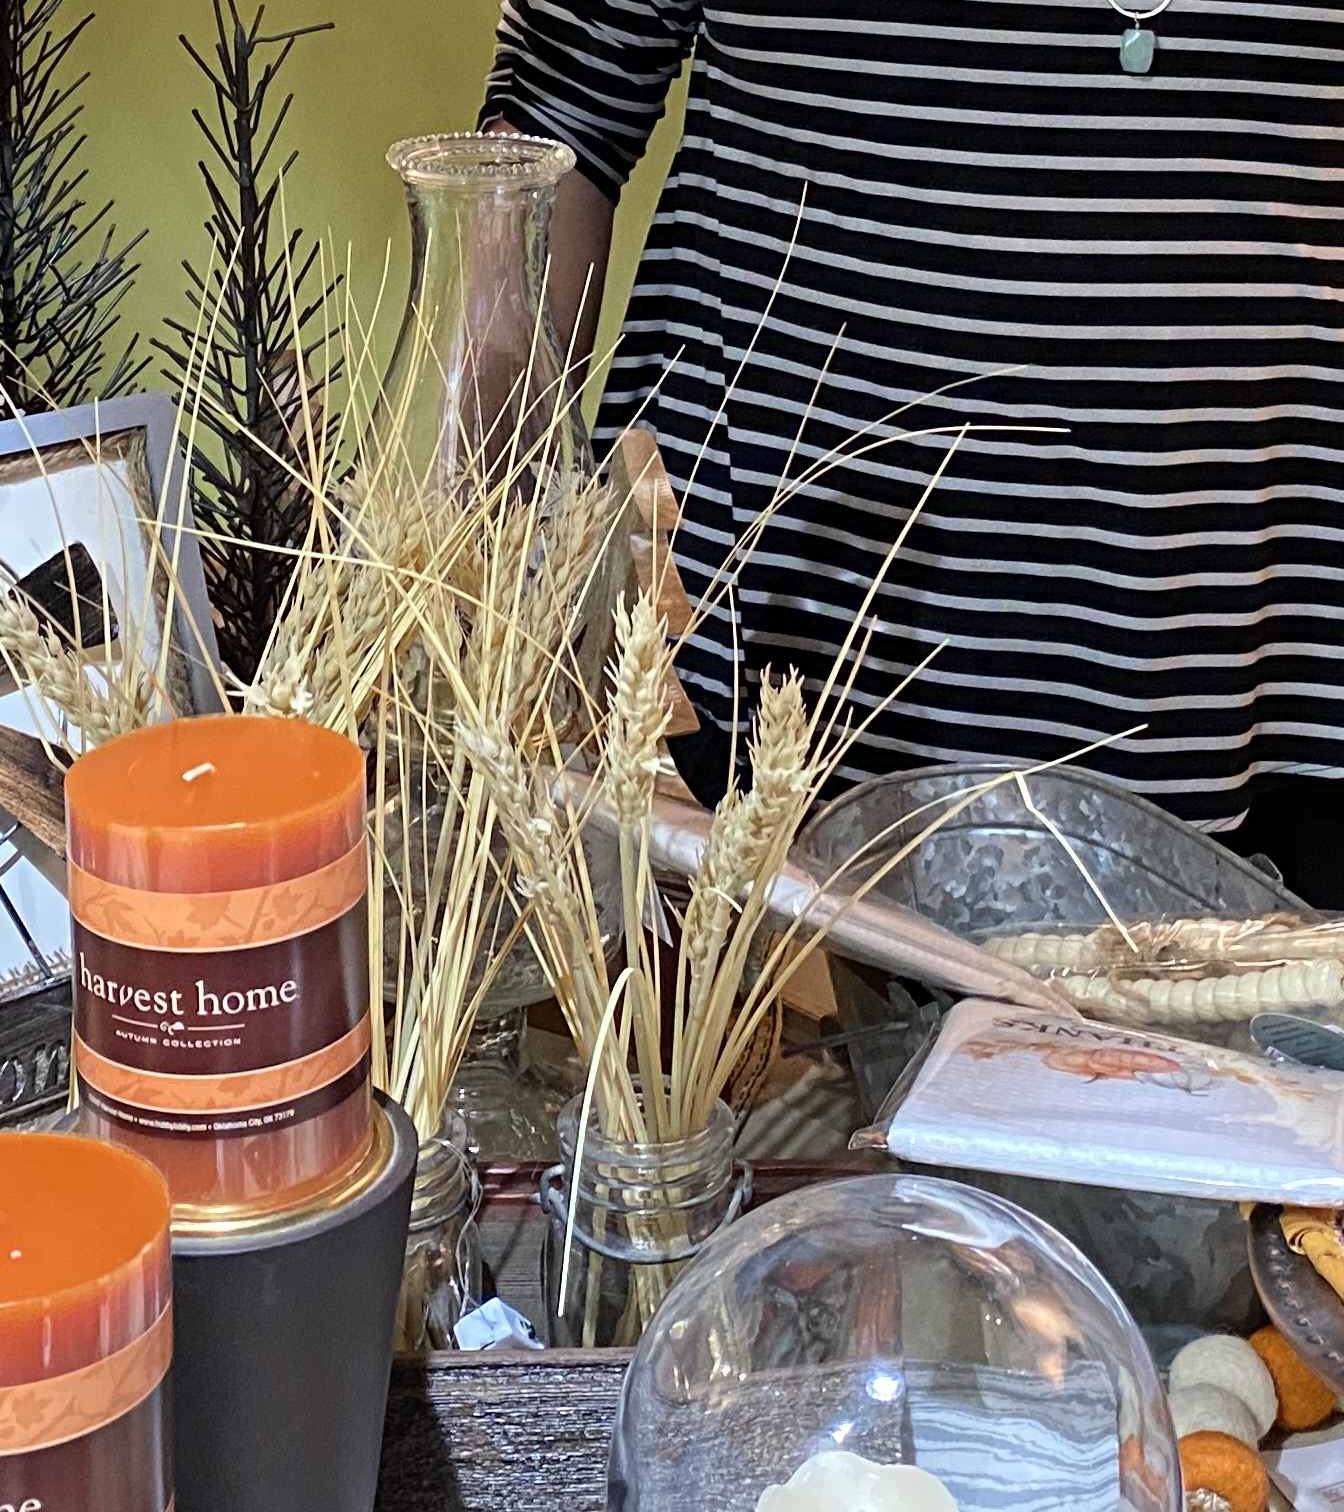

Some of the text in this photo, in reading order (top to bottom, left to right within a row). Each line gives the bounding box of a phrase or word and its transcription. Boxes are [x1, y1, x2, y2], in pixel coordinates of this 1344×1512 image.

[79, 951, 299, 1016] harvest home
[115, 1029, 242, 1048] AUTUMN COLLECTION
